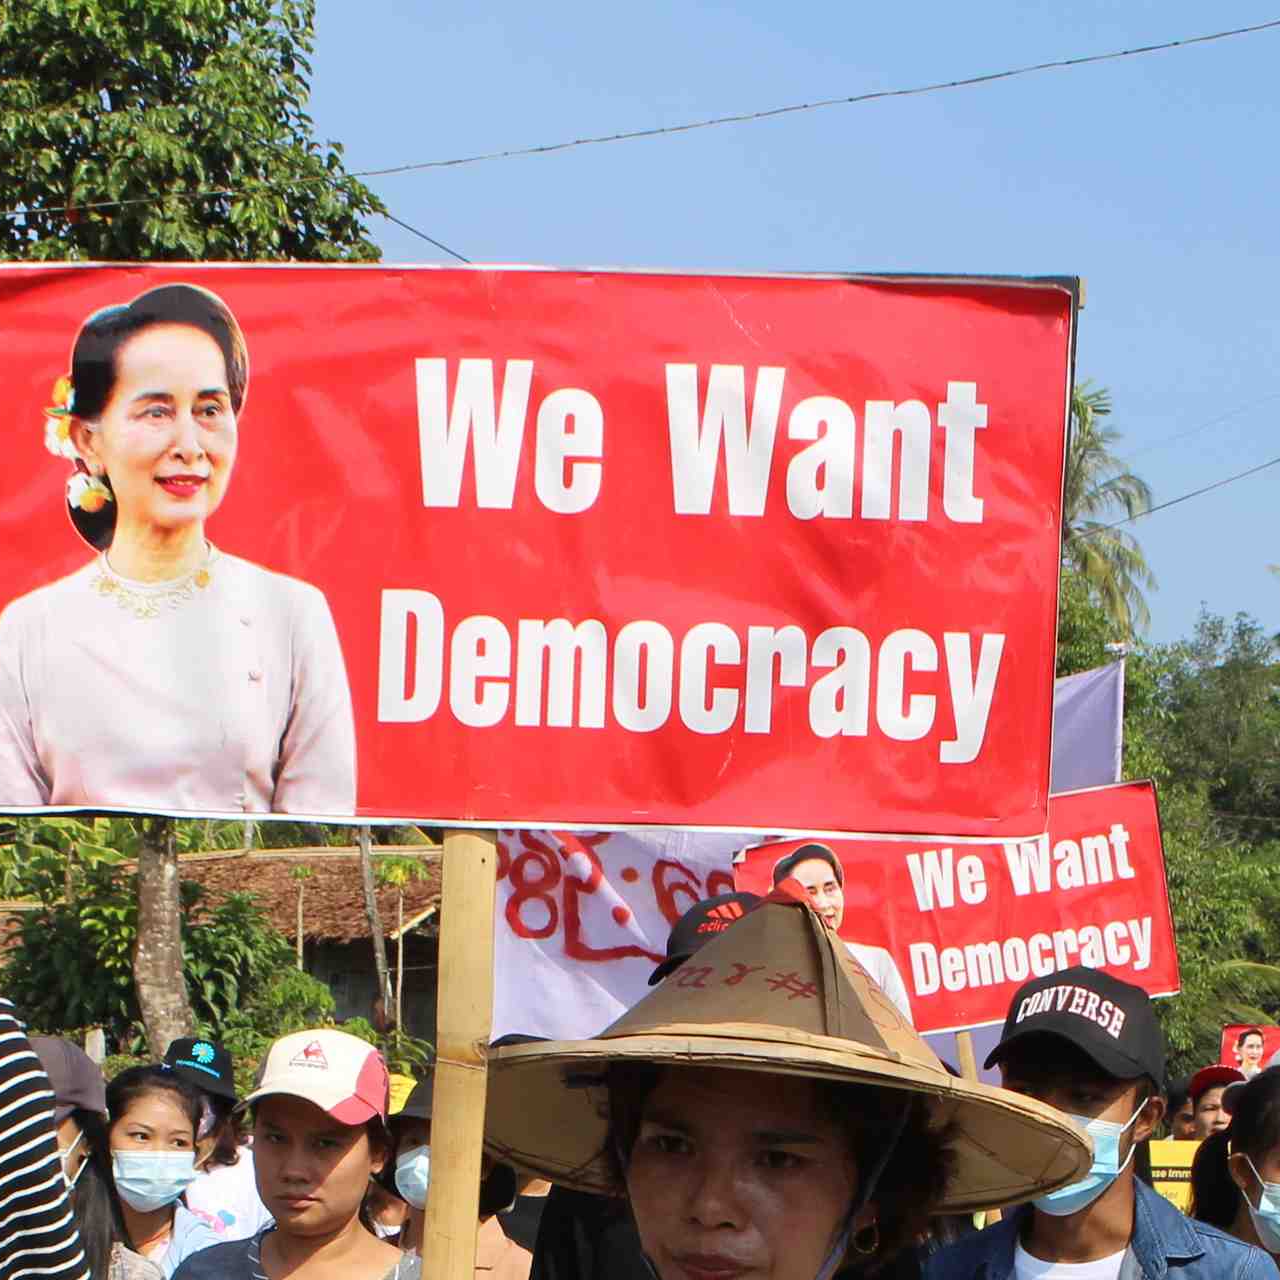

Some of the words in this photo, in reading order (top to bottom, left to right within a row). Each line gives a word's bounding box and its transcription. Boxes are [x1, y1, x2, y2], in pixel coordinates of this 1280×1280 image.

[415, 357, 604, 514] We
[664, 362, 988, 524] Want
[377, 589, 1006, 764] Democracy
[906, 847, 988, 912] We
[1003, 823, 1136, 897] Want
[908, 916, 1153, 997] Democracy
[1015, 985, 1126, 1039] CONVERSE
